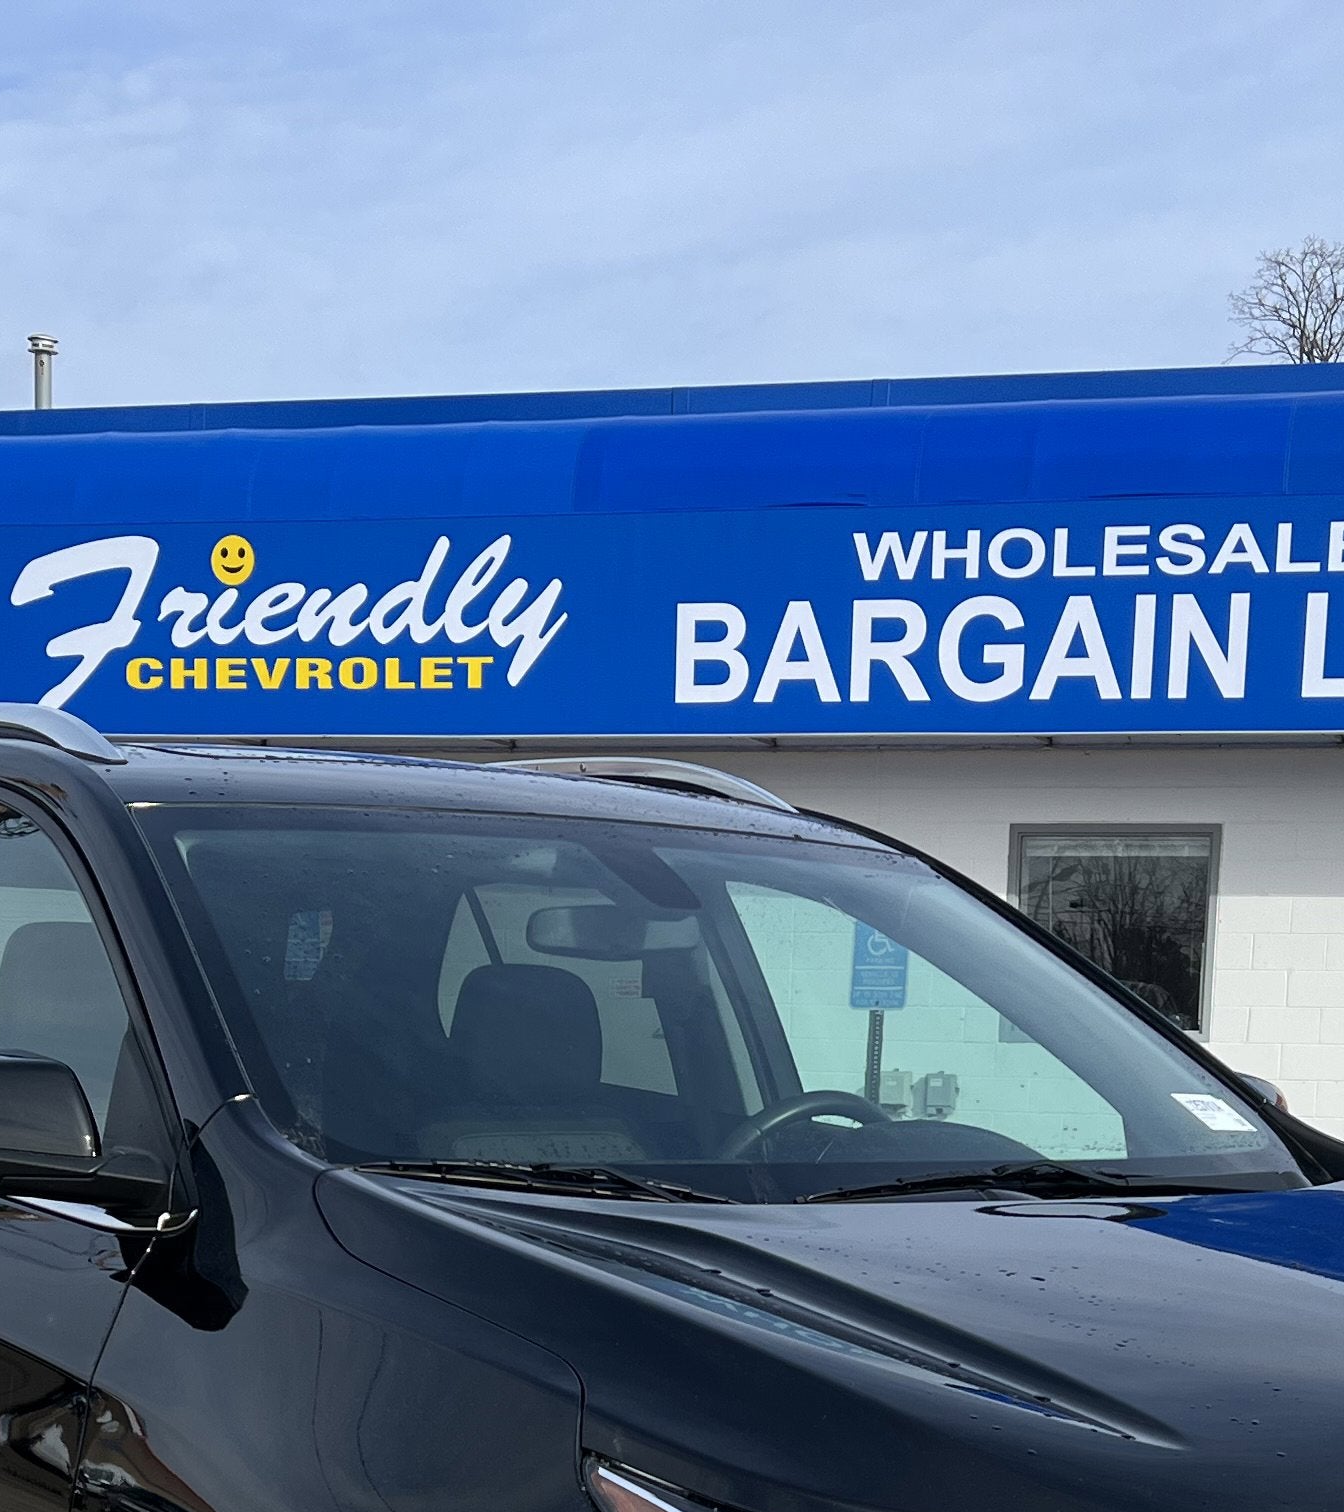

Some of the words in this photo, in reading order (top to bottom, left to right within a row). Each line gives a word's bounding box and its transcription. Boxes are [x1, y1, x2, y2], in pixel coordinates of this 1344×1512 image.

[10, 533, 568, 708] Friendly
[126, 656, 493, 690] CHEVROLET
[674, 593, 1250, 704] BARGAIN
